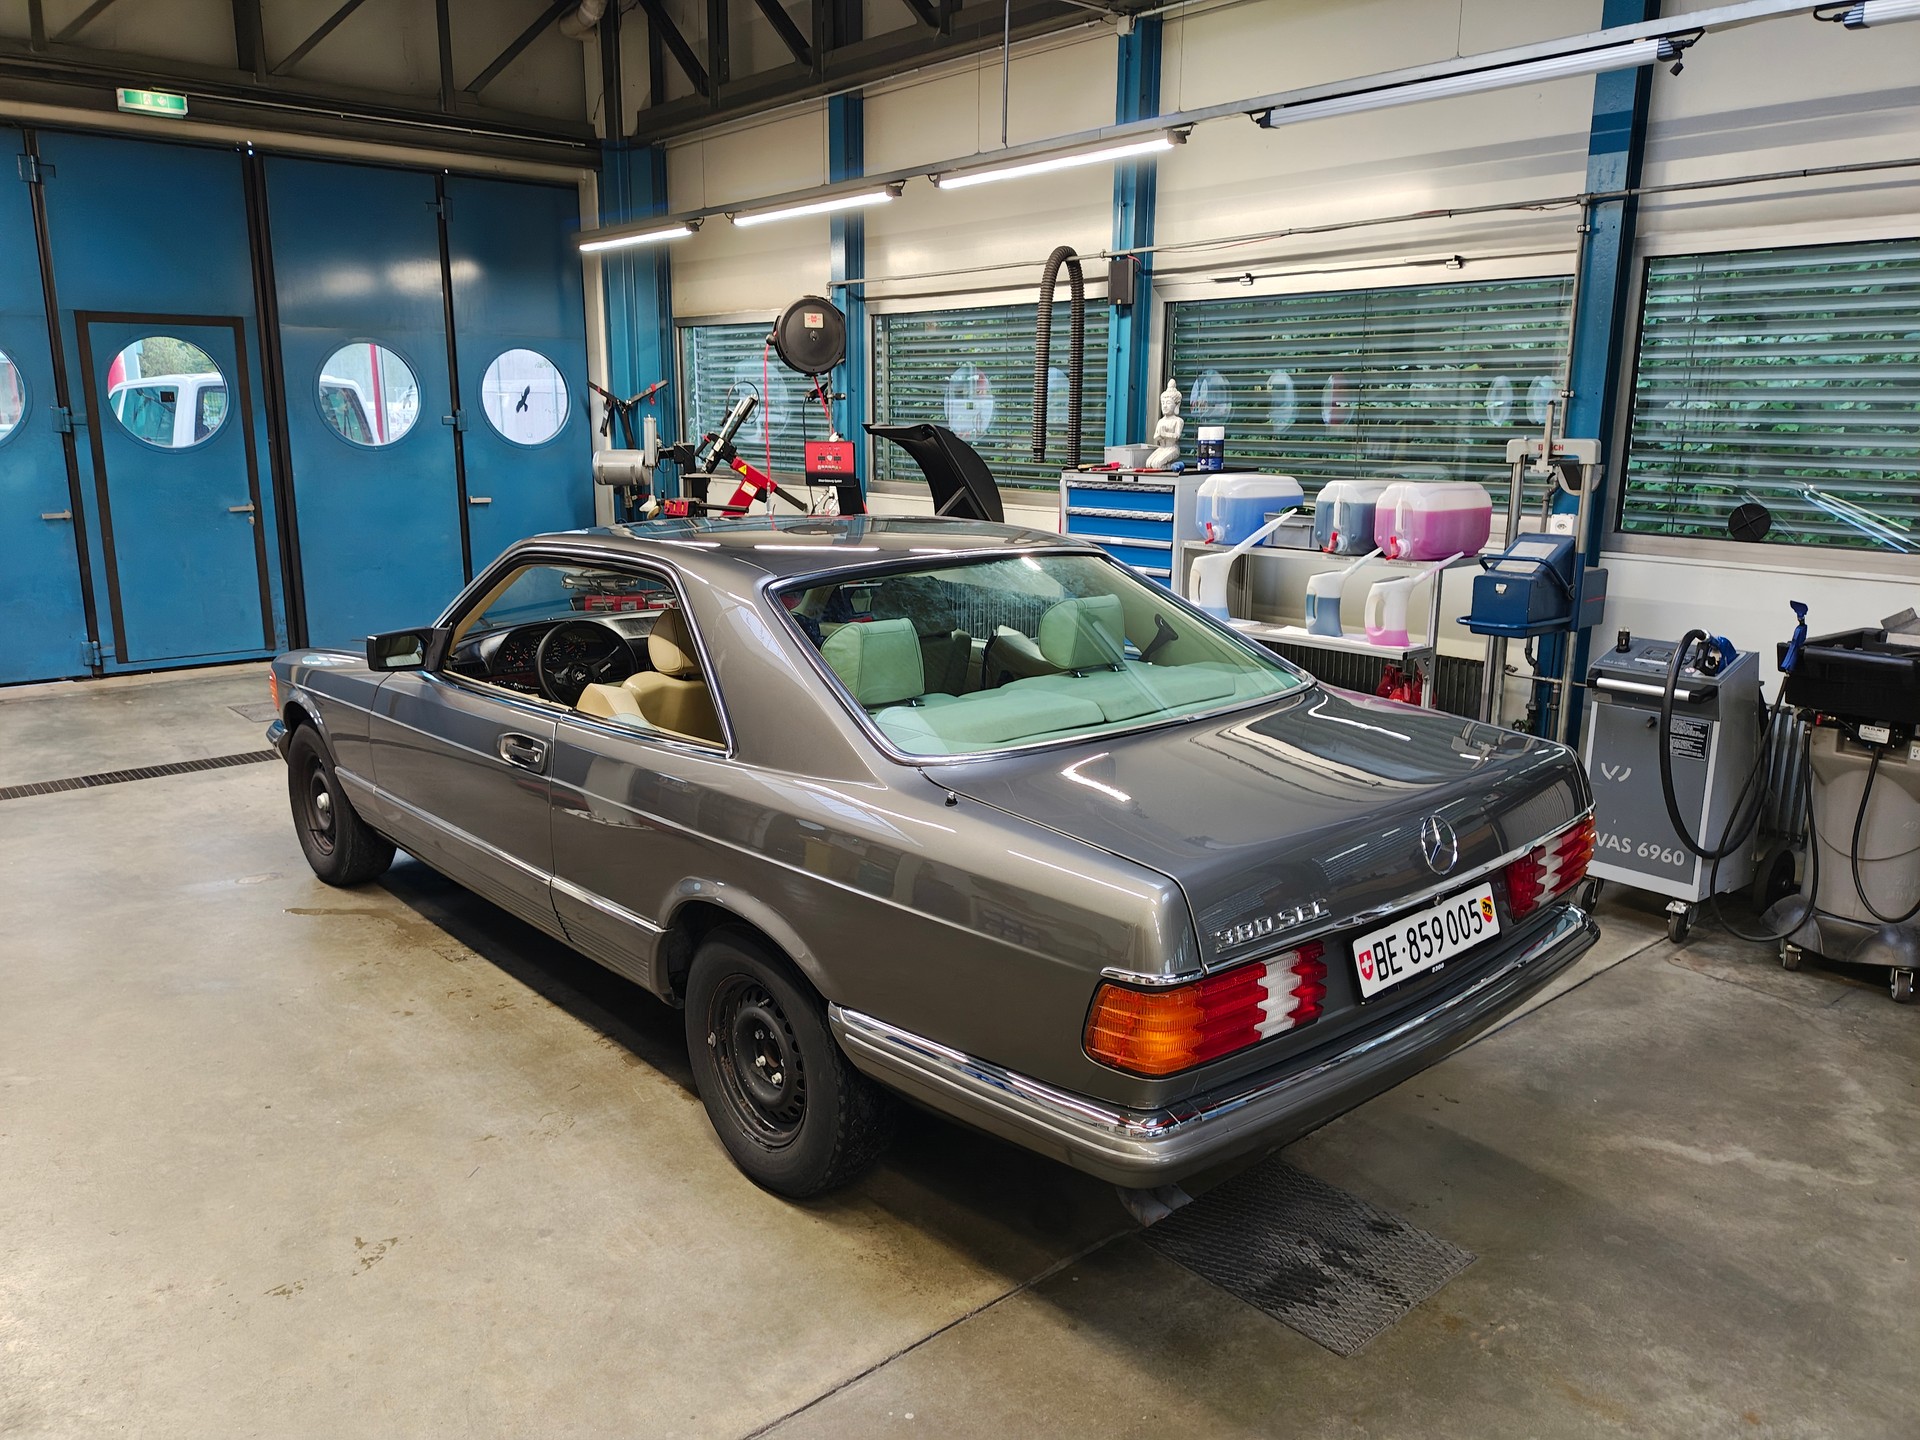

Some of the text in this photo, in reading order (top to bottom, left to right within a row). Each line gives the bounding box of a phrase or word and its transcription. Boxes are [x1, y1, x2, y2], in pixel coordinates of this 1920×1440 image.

[1537, 443, 1564, 452] BSCH
[1595, 830, 1685, 866] VAS 6960
